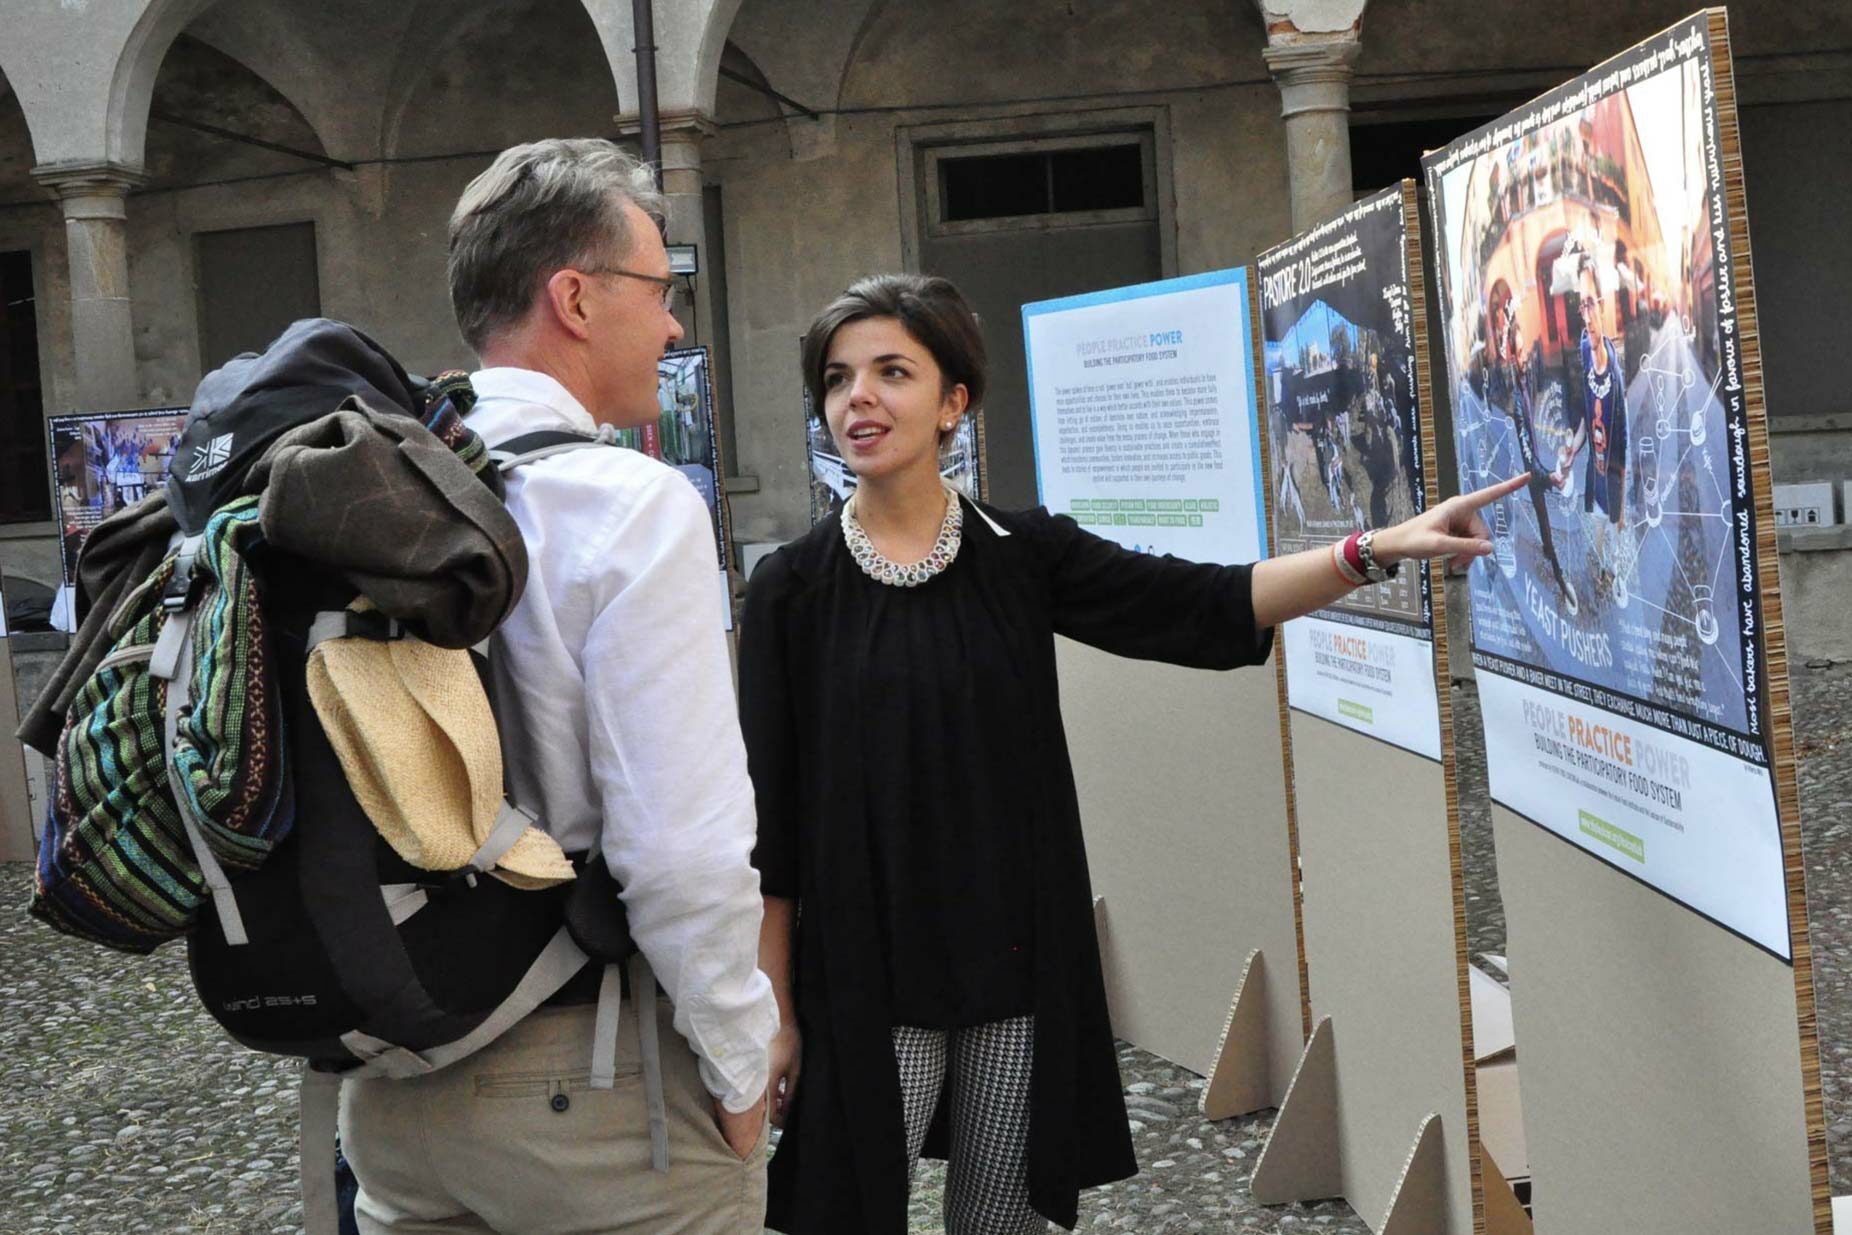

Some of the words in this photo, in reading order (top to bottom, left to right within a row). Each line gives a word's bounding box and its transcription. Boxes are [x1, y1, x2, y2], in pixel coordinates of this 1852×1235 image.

[1713, 227, 1728, 263] and
[1263, 263, 1297, 310] PASTORE
[1150, 330, 1183, 347] POWER
[1720, 318, 1735, 334] of
[1725, 338, 1741, 392] favour
[1728, 415, 1747, 498] sourdough
[1734, 508, 1749, 593] abandoned
[1525, 572, 1558, 640] YEAST
[1560, 618, 1613, 669] PUSHERS
[1740, 599, 1754, 637] have
[1333, 632, 1367, 660] PRACTICE
[1522, 698, 1566, 739] PEOPLE
[1568, 715, 1633, 766] PRACTICE
[1635, 739, 1691, 790] POWER
[1545, 673, 1557, 690] MEET
[1607, 694, 1635, 716] EXCHANGE
[1635, 704, 1653, 723] MUCH
[1653, 708, 1671, 729] MORE
[1670, 715, 1688, 735] THAN
[1688, 720, 1701, 740] JUST
[1708, 727, 1728, 749] PIECE
[1728, 733, 1738, 751] OF
[1738, 738, 1768, 763] DOUGH.
[1534, 732, 1563, 760] BUILDING
[1563, 744, 1576, 766] THE
[1576, 750, 1627, 787] PARTICIPATORY
[1629, 771, 1649, 796] FOOD
[1650, 780, 1682, 811] SYSTEM
